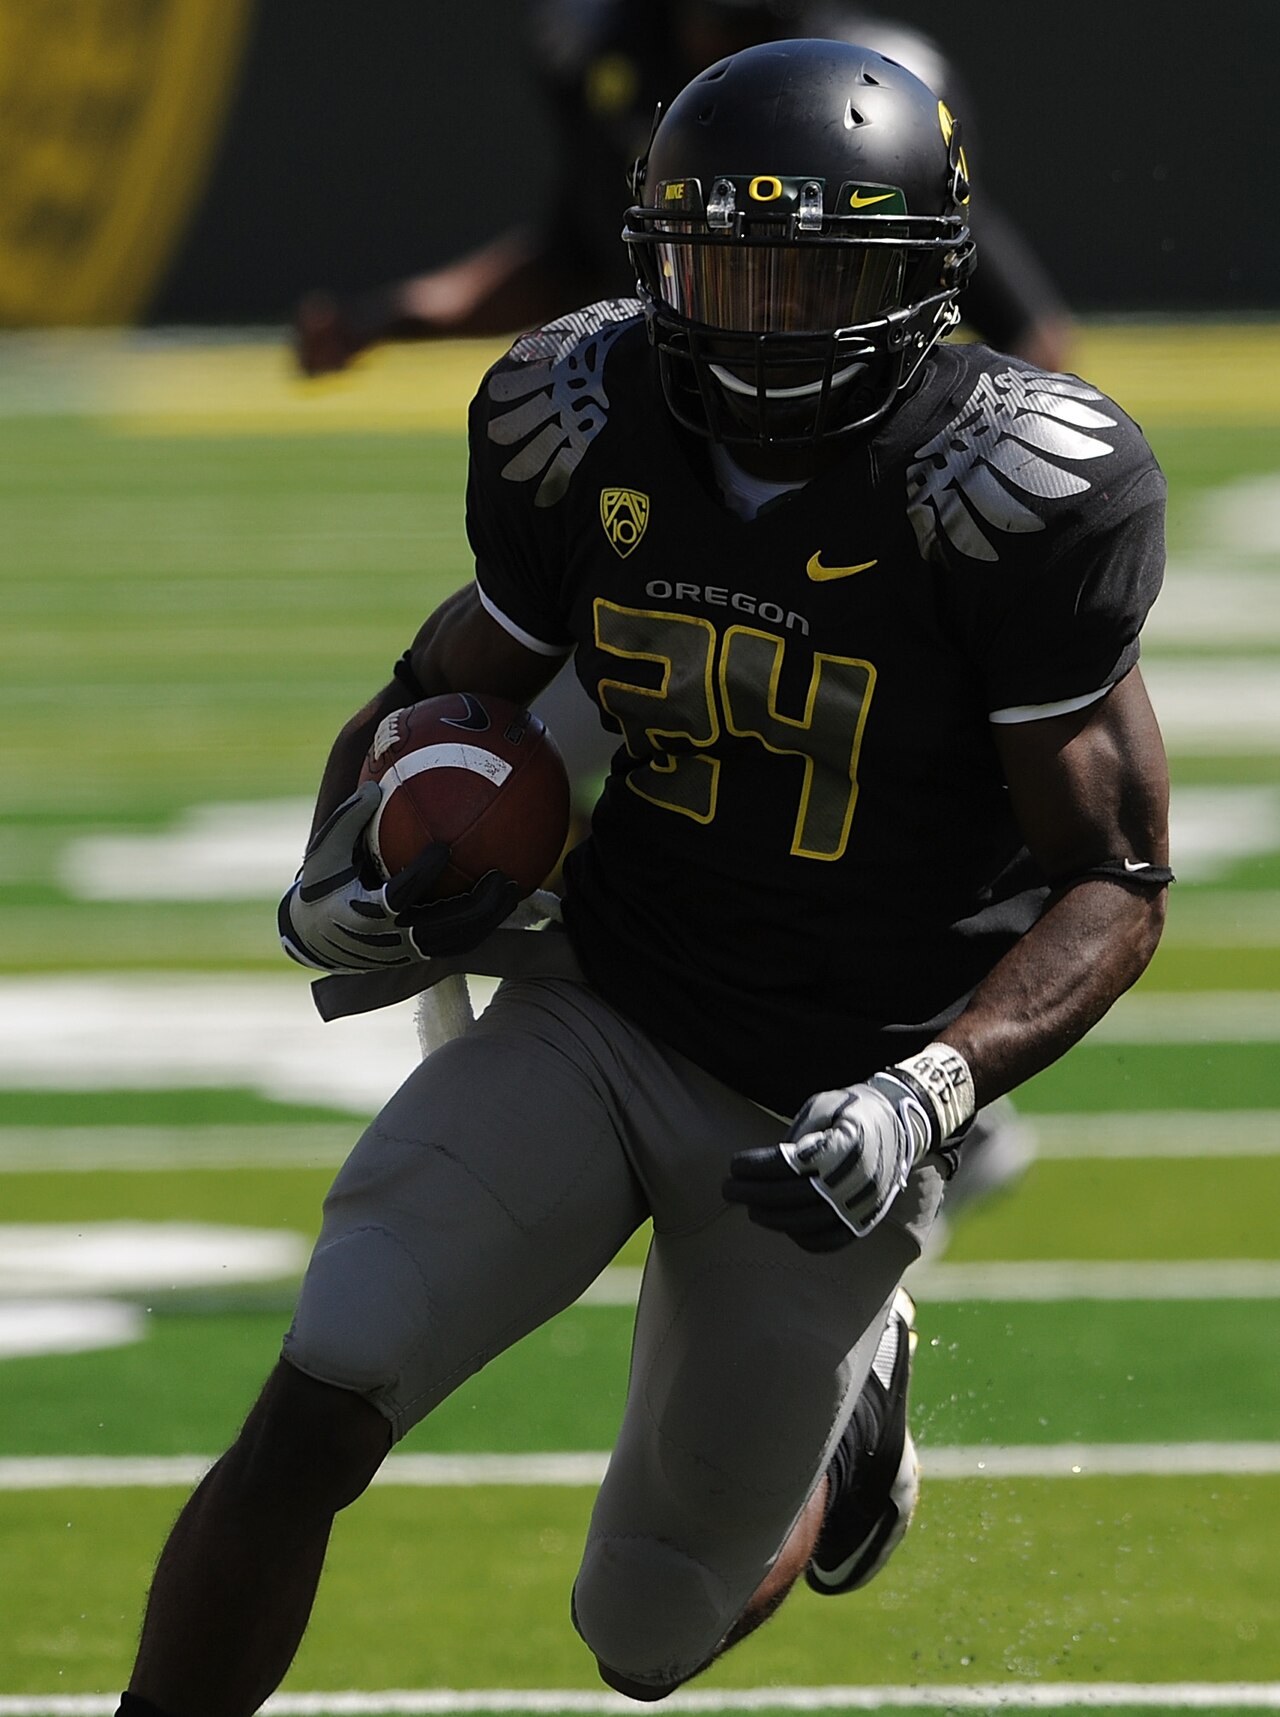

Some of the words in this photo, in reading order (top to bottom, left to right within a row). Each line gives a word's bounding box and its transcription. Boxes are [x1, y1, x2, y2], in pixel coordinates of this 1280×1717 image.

[665, 183, 685, 200] NIKE
[603, 491, 646, 533] PAC
[612, 518, 637, 544] 10
[645, 579, 809, 636] OREGON
[593, 597, 877, 861] 24
[940, 1056, 967, 1088] IN
